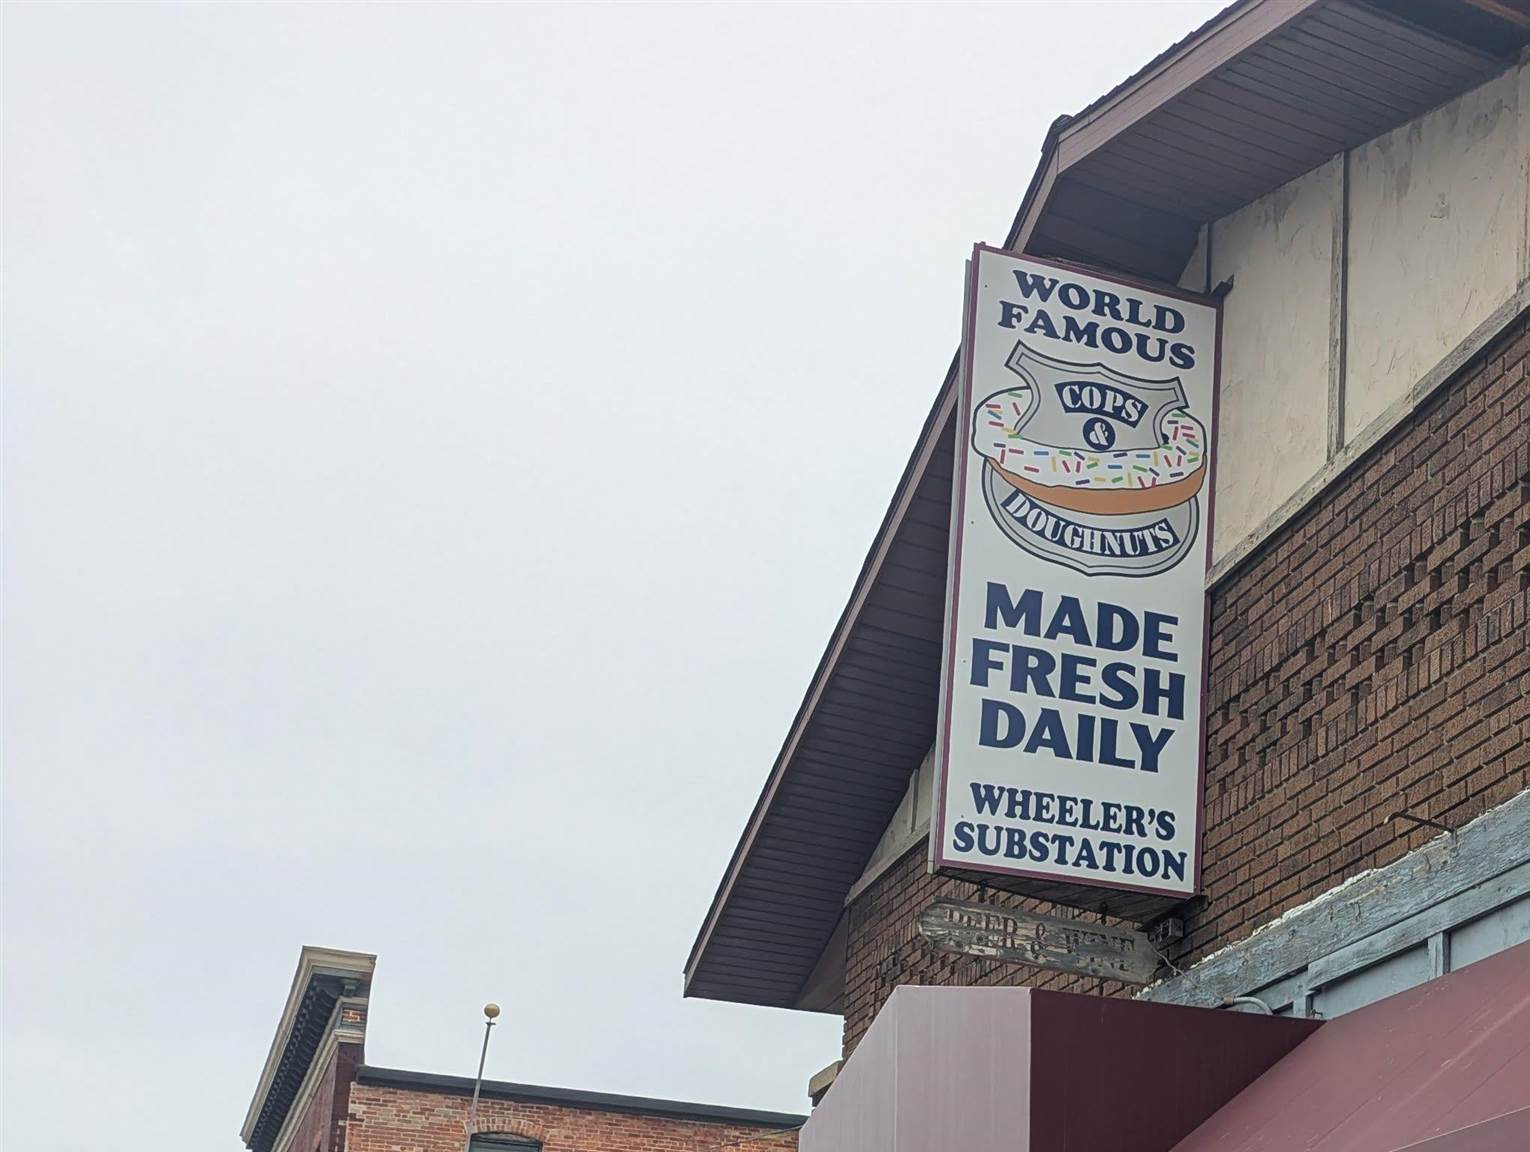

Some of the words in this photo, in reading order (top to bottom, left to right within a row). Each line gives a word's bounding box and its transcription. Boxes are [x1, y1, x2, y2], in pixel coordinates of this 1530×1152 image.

[1012, 269, 1186, 335] WORLD
[997, 300, 1196, 370] FAMOUS
[1060, 384, 1143, 426] COPS
[1089, 421, 1109, 447] &
[1004, 492, 1177, 557] DOUGHNUTS
[984, 581, 1180, 663] MADE
[969, 637, 1186, 721] FRESH
[978, 697, 1176, 774] DAILY
[969, 782, 1176, 841] WHEELER'S
[952, 821, 1188, 882] SUBSTATION
